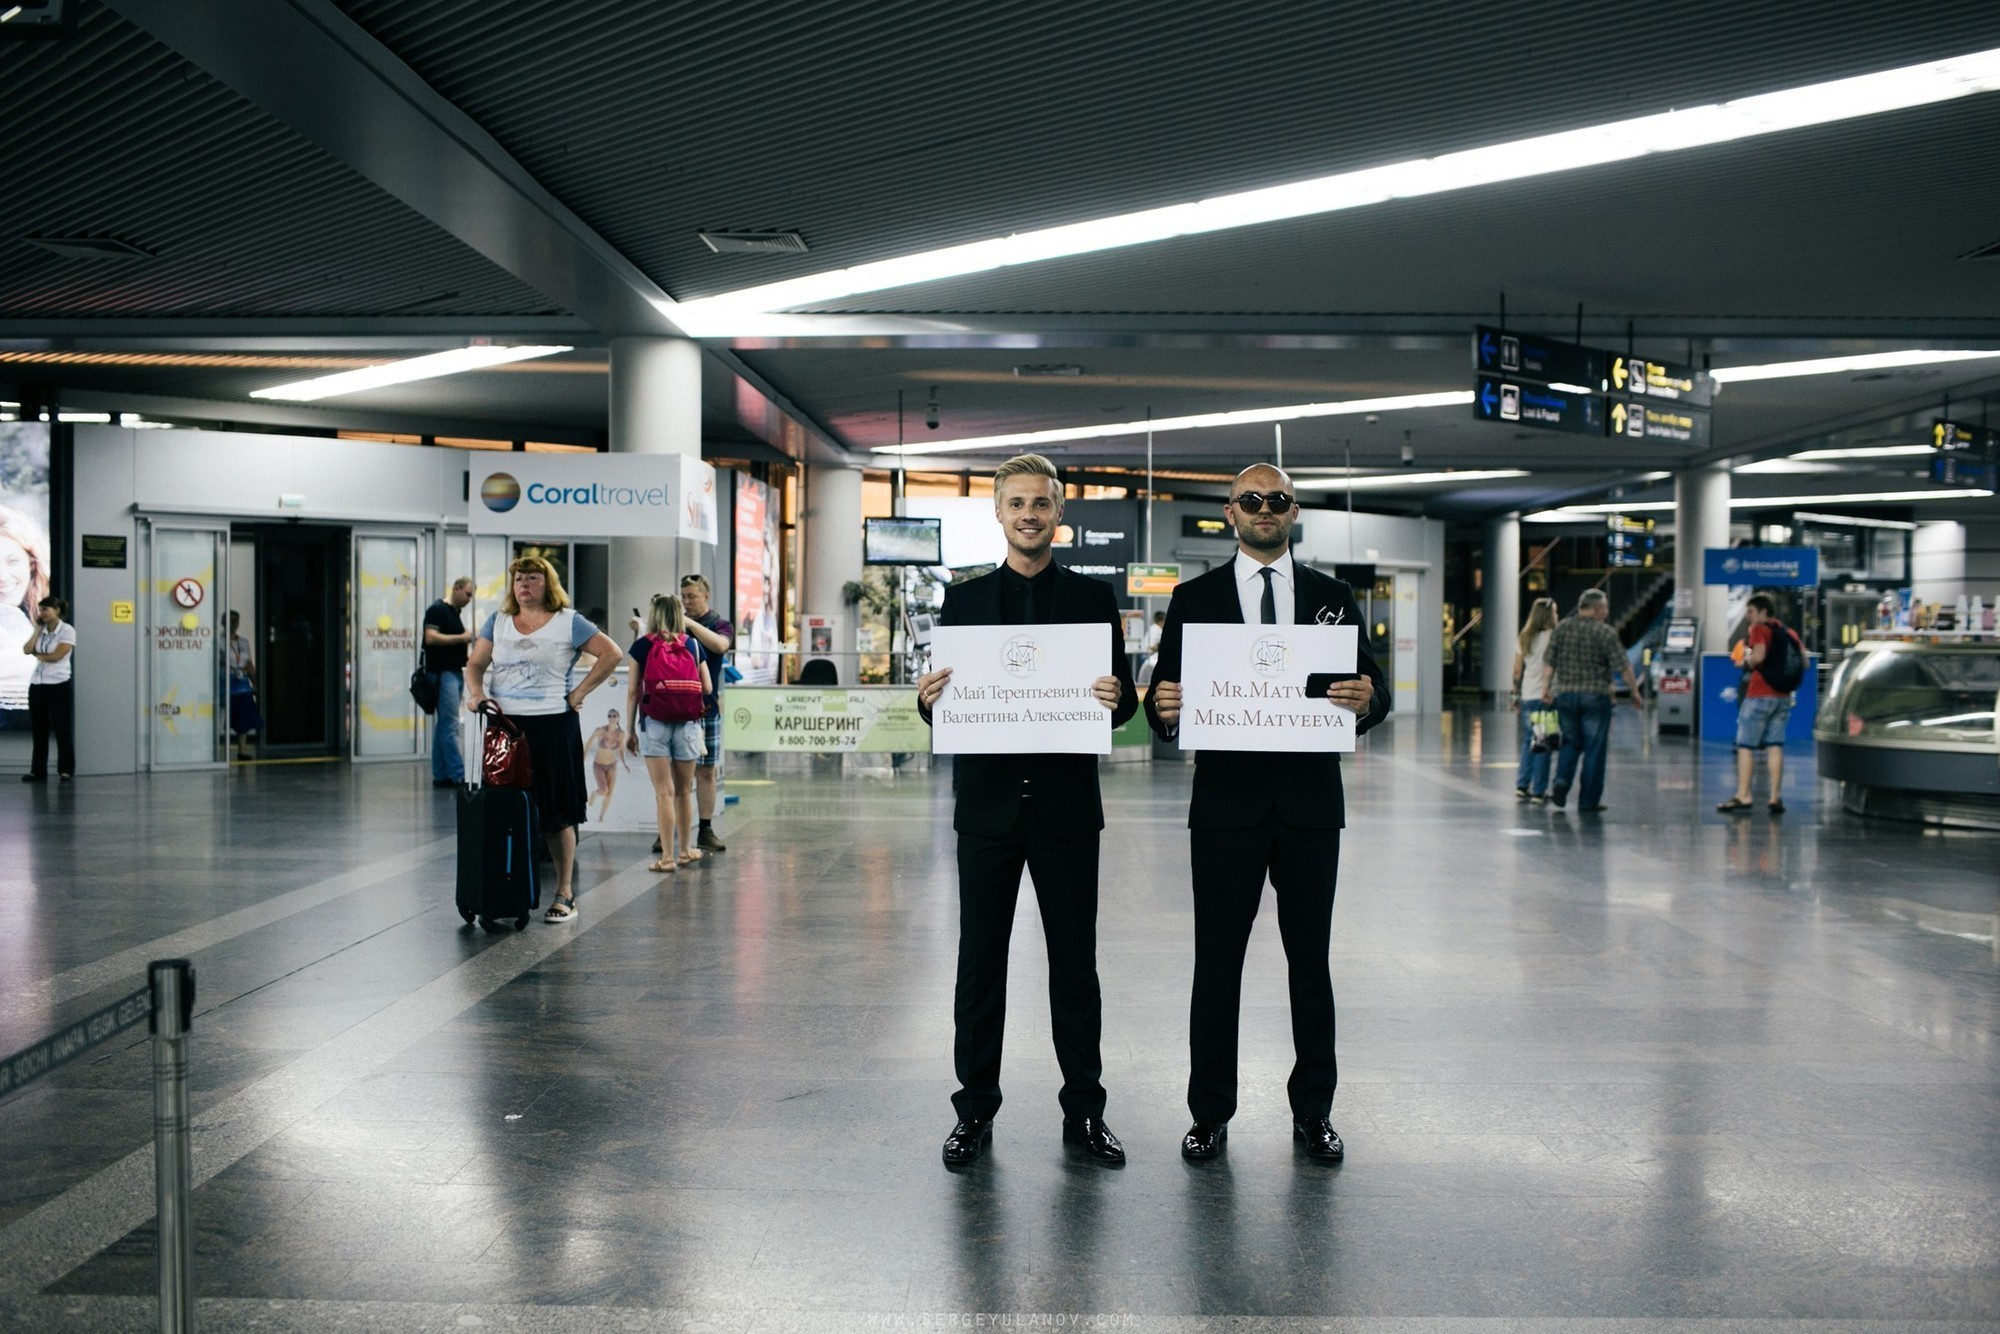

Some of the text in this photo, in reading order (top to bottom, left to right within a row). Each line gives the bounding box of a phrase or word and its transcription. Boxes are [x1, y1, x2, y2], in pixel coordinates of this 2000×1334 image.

[953, 685, 985, 701] Май
[988, 685, 1079, 703] Терентьевич
[942, 708, 1104, 724] Валентина Алексеевна
[775, 717, 864, 731] КАРШЕРИНГ
[779, 736, 856, 746] 8-800-700-95-74
